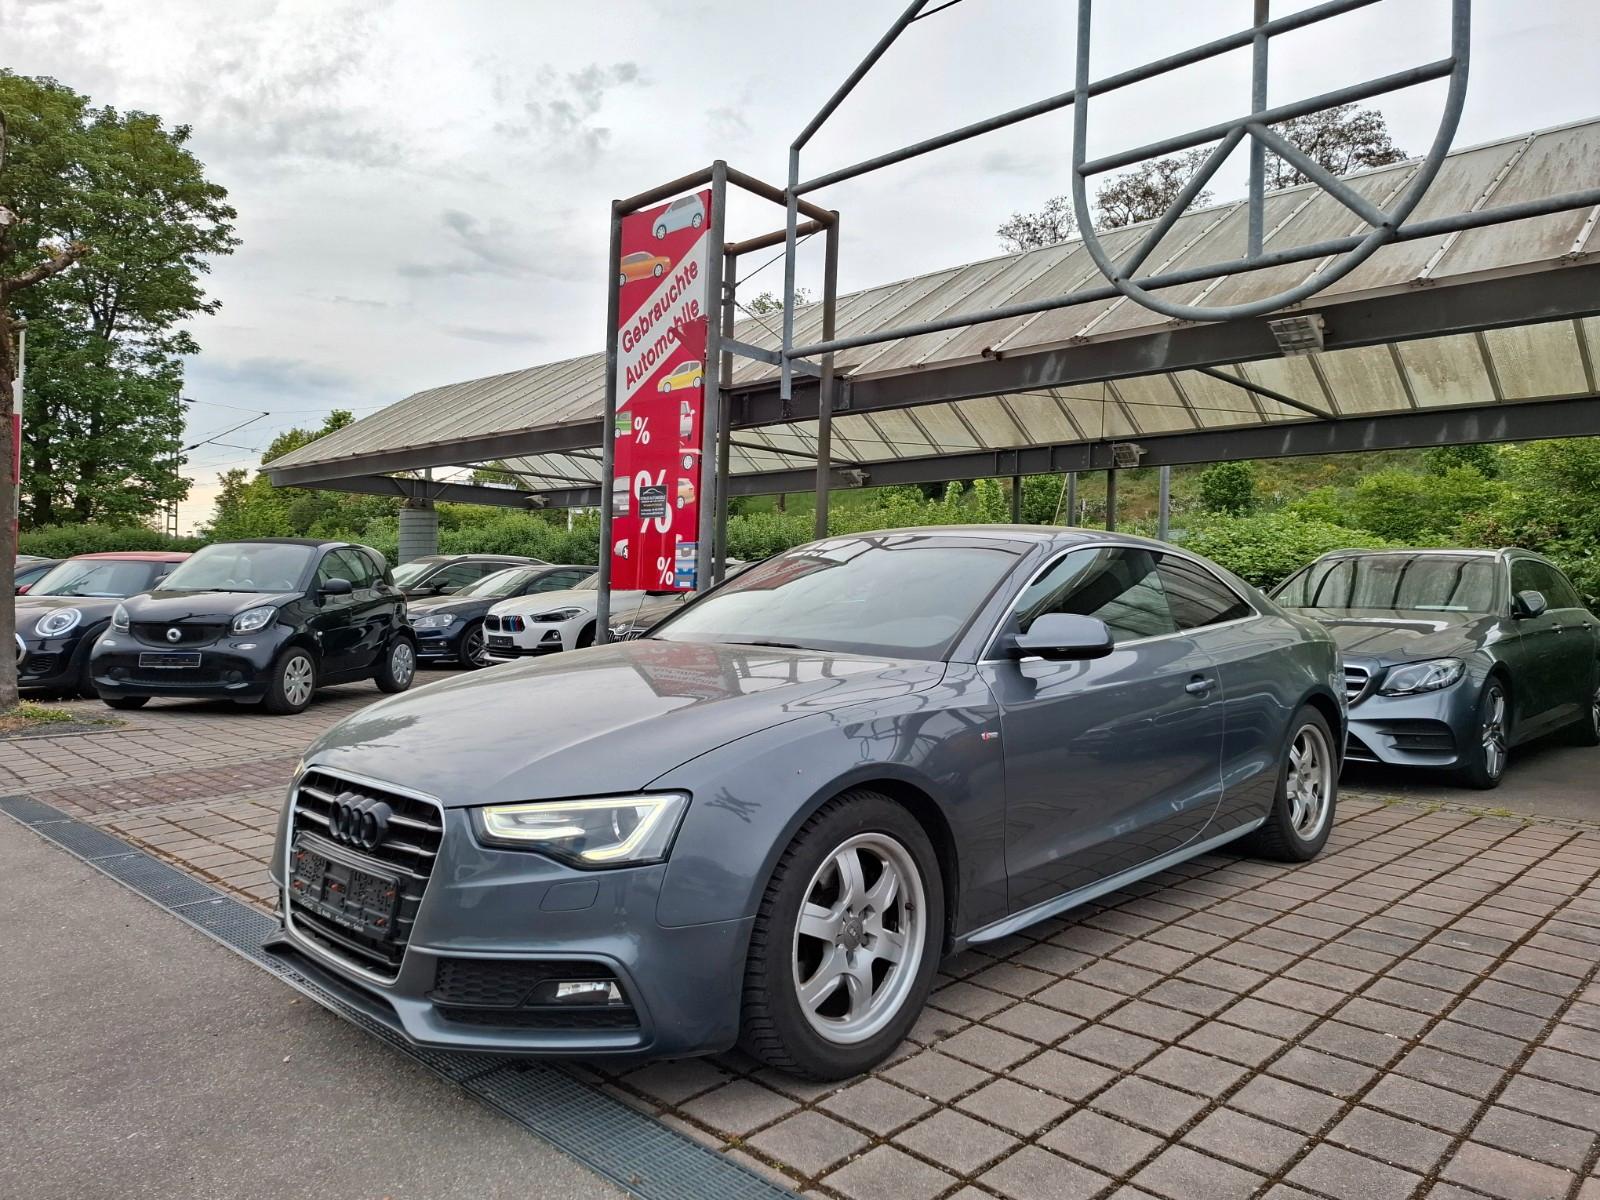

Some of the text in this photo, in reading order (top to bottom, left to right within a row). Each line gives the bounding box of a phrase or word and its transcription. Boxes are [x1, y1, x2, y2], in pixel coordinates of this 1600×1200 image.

[622, 261, 698, 353] Gebrauchte
[634, 416, 650, 444] %
[657, 556, 674, 585] %
